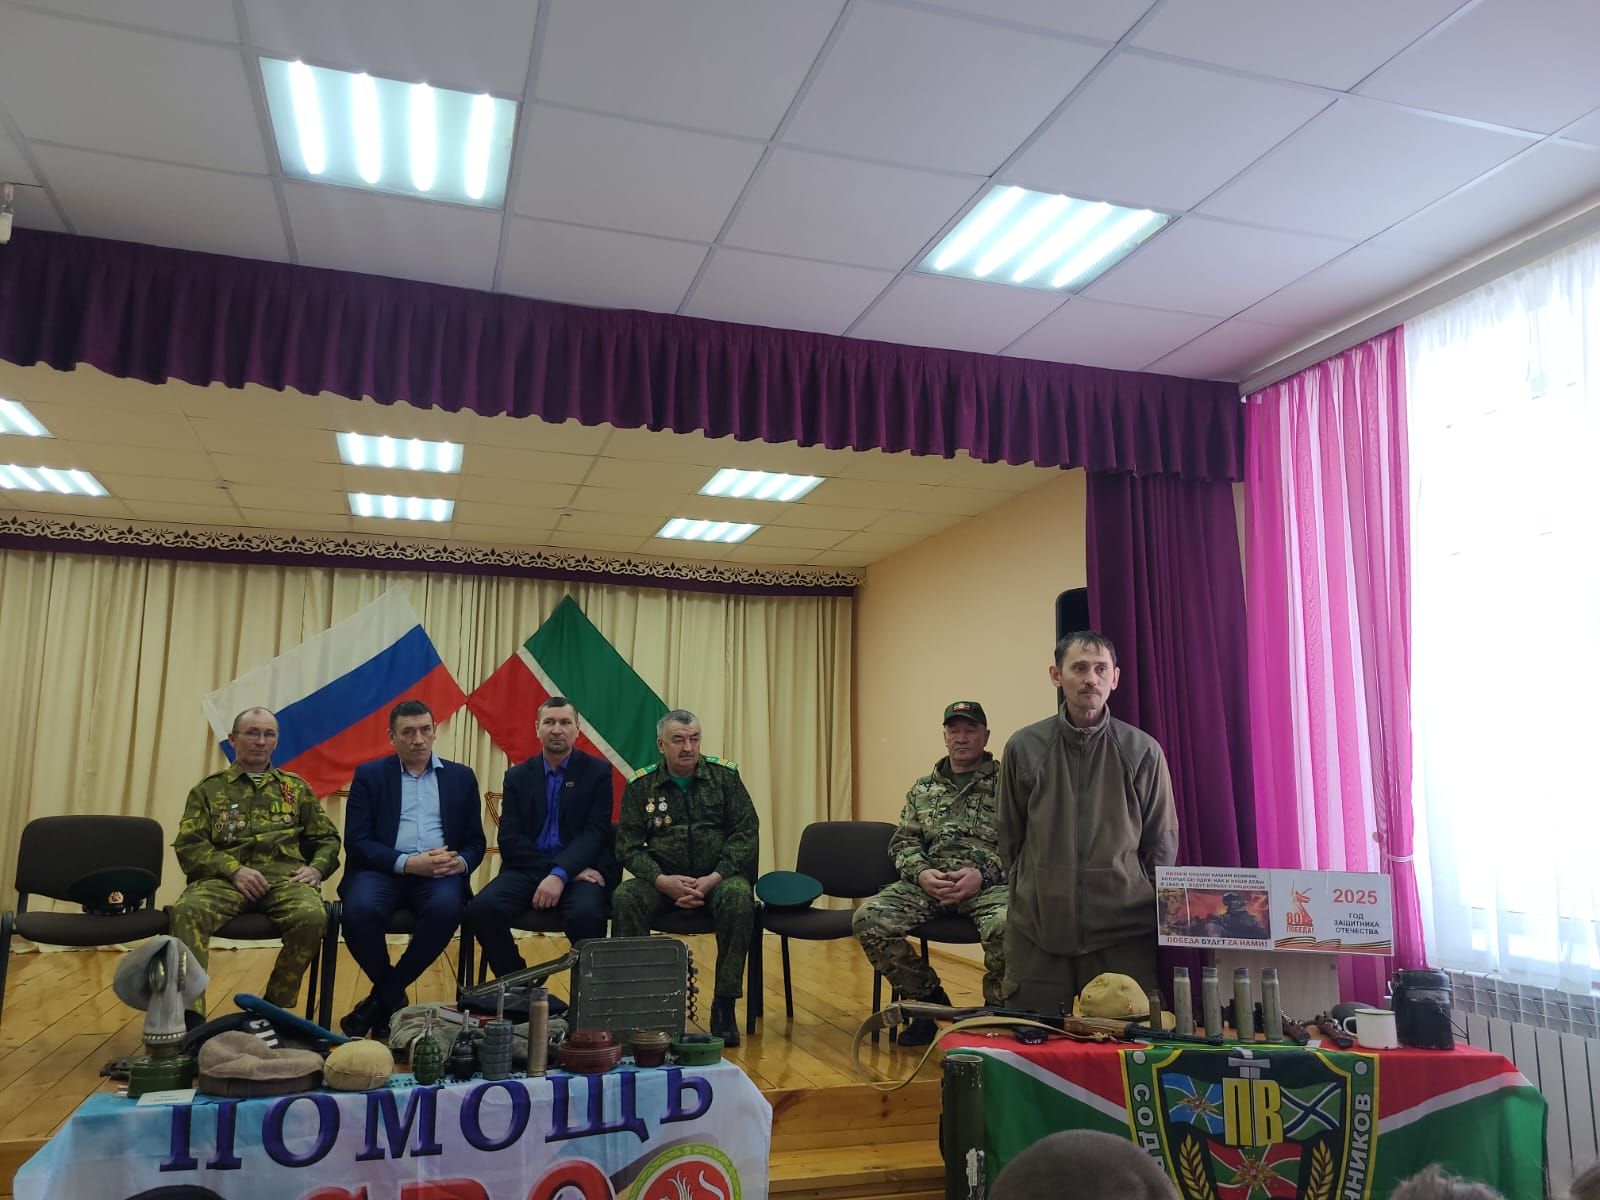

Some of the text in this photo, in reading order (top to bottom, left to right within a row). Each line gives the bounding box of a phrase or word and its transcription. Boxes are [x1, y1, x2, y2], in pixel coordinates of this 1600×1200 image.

[1333, 888, 1378, 905] 2025
[1286, 911, 1302, 925] 80
[1348, 912, 1364, 920] ГОД
[1333, 919, 1380, 928] ЗАЩИТНИКА
[1335, 927, 1379, 935] ОТЕЧЕСТВА
[1167, 936, 1199, 944] ПОБЕДА
[1201, 938, 1225, 946] БУДЕТ
[1222, 1077, 1286, 1148] ПВ
[159, 1067, 713, 1173] ПОМОЩЬ
